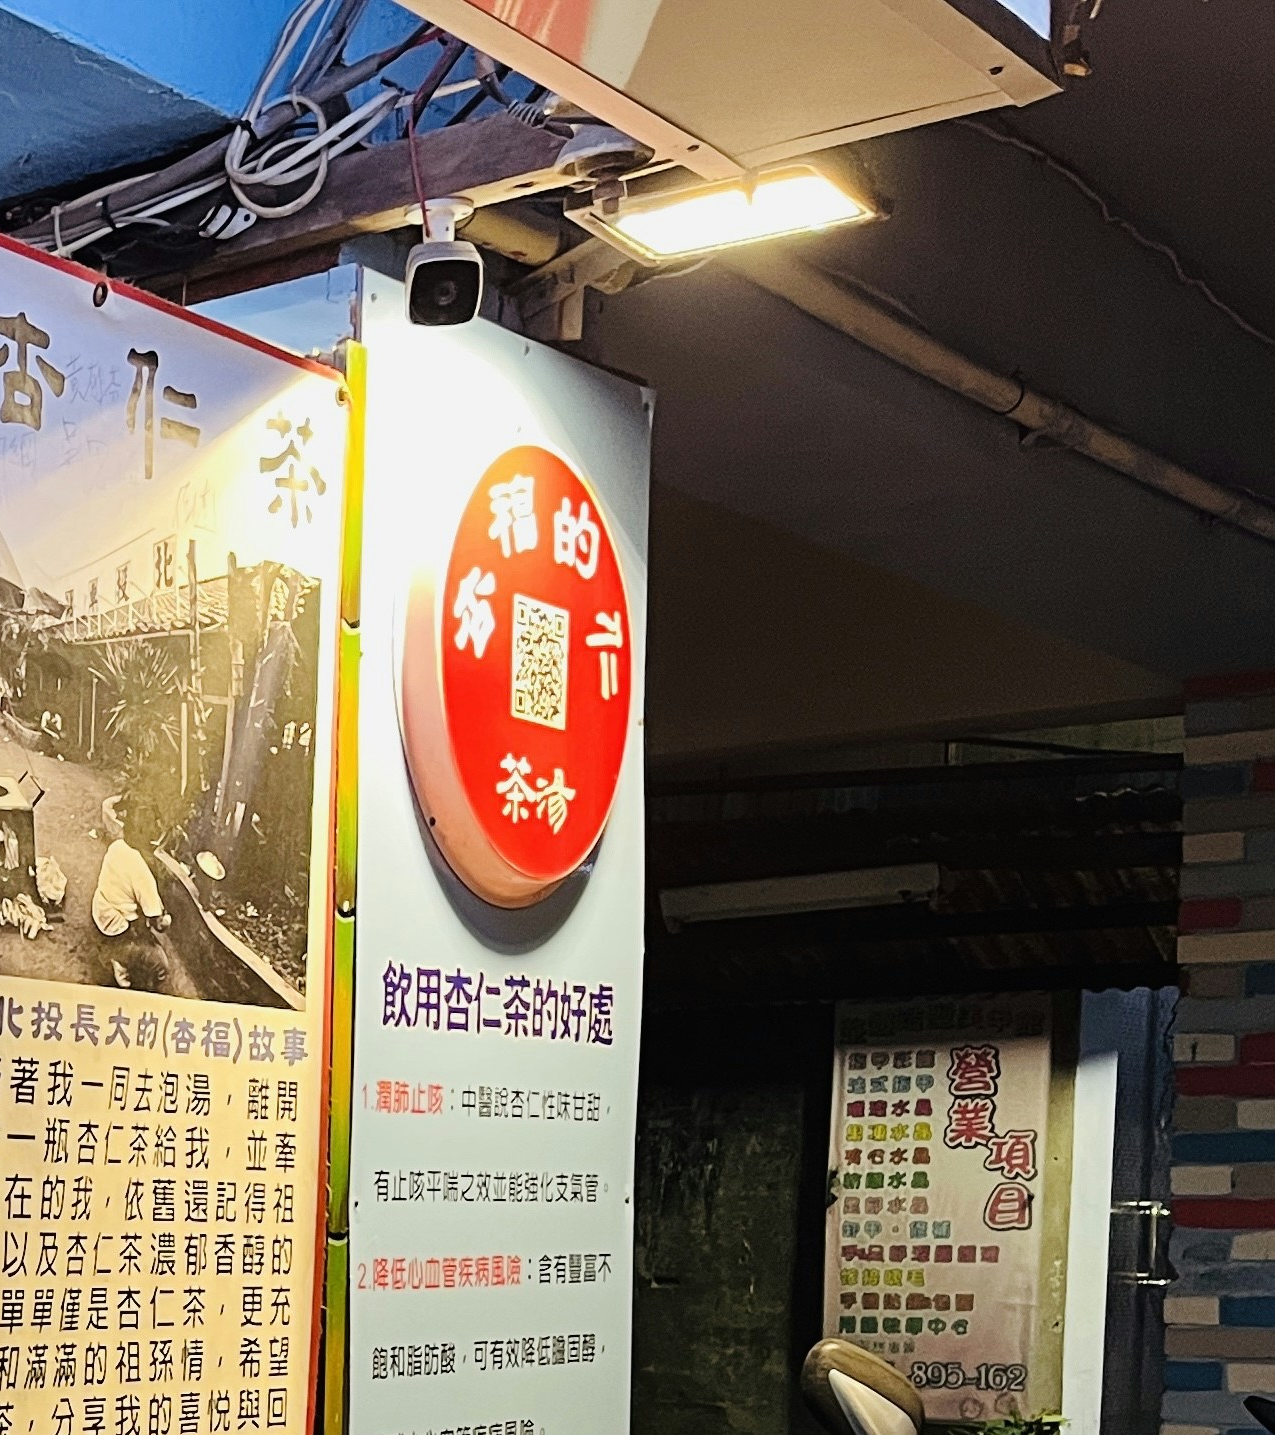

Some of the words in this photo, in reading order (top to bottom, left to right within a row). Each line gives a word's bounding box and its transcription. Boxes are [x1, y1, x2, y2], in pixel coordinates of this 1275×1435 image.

[382, 959, 615, 1046] 飲用杏仁茶的好處
[944, 1044, 1000, 1149] 營業
